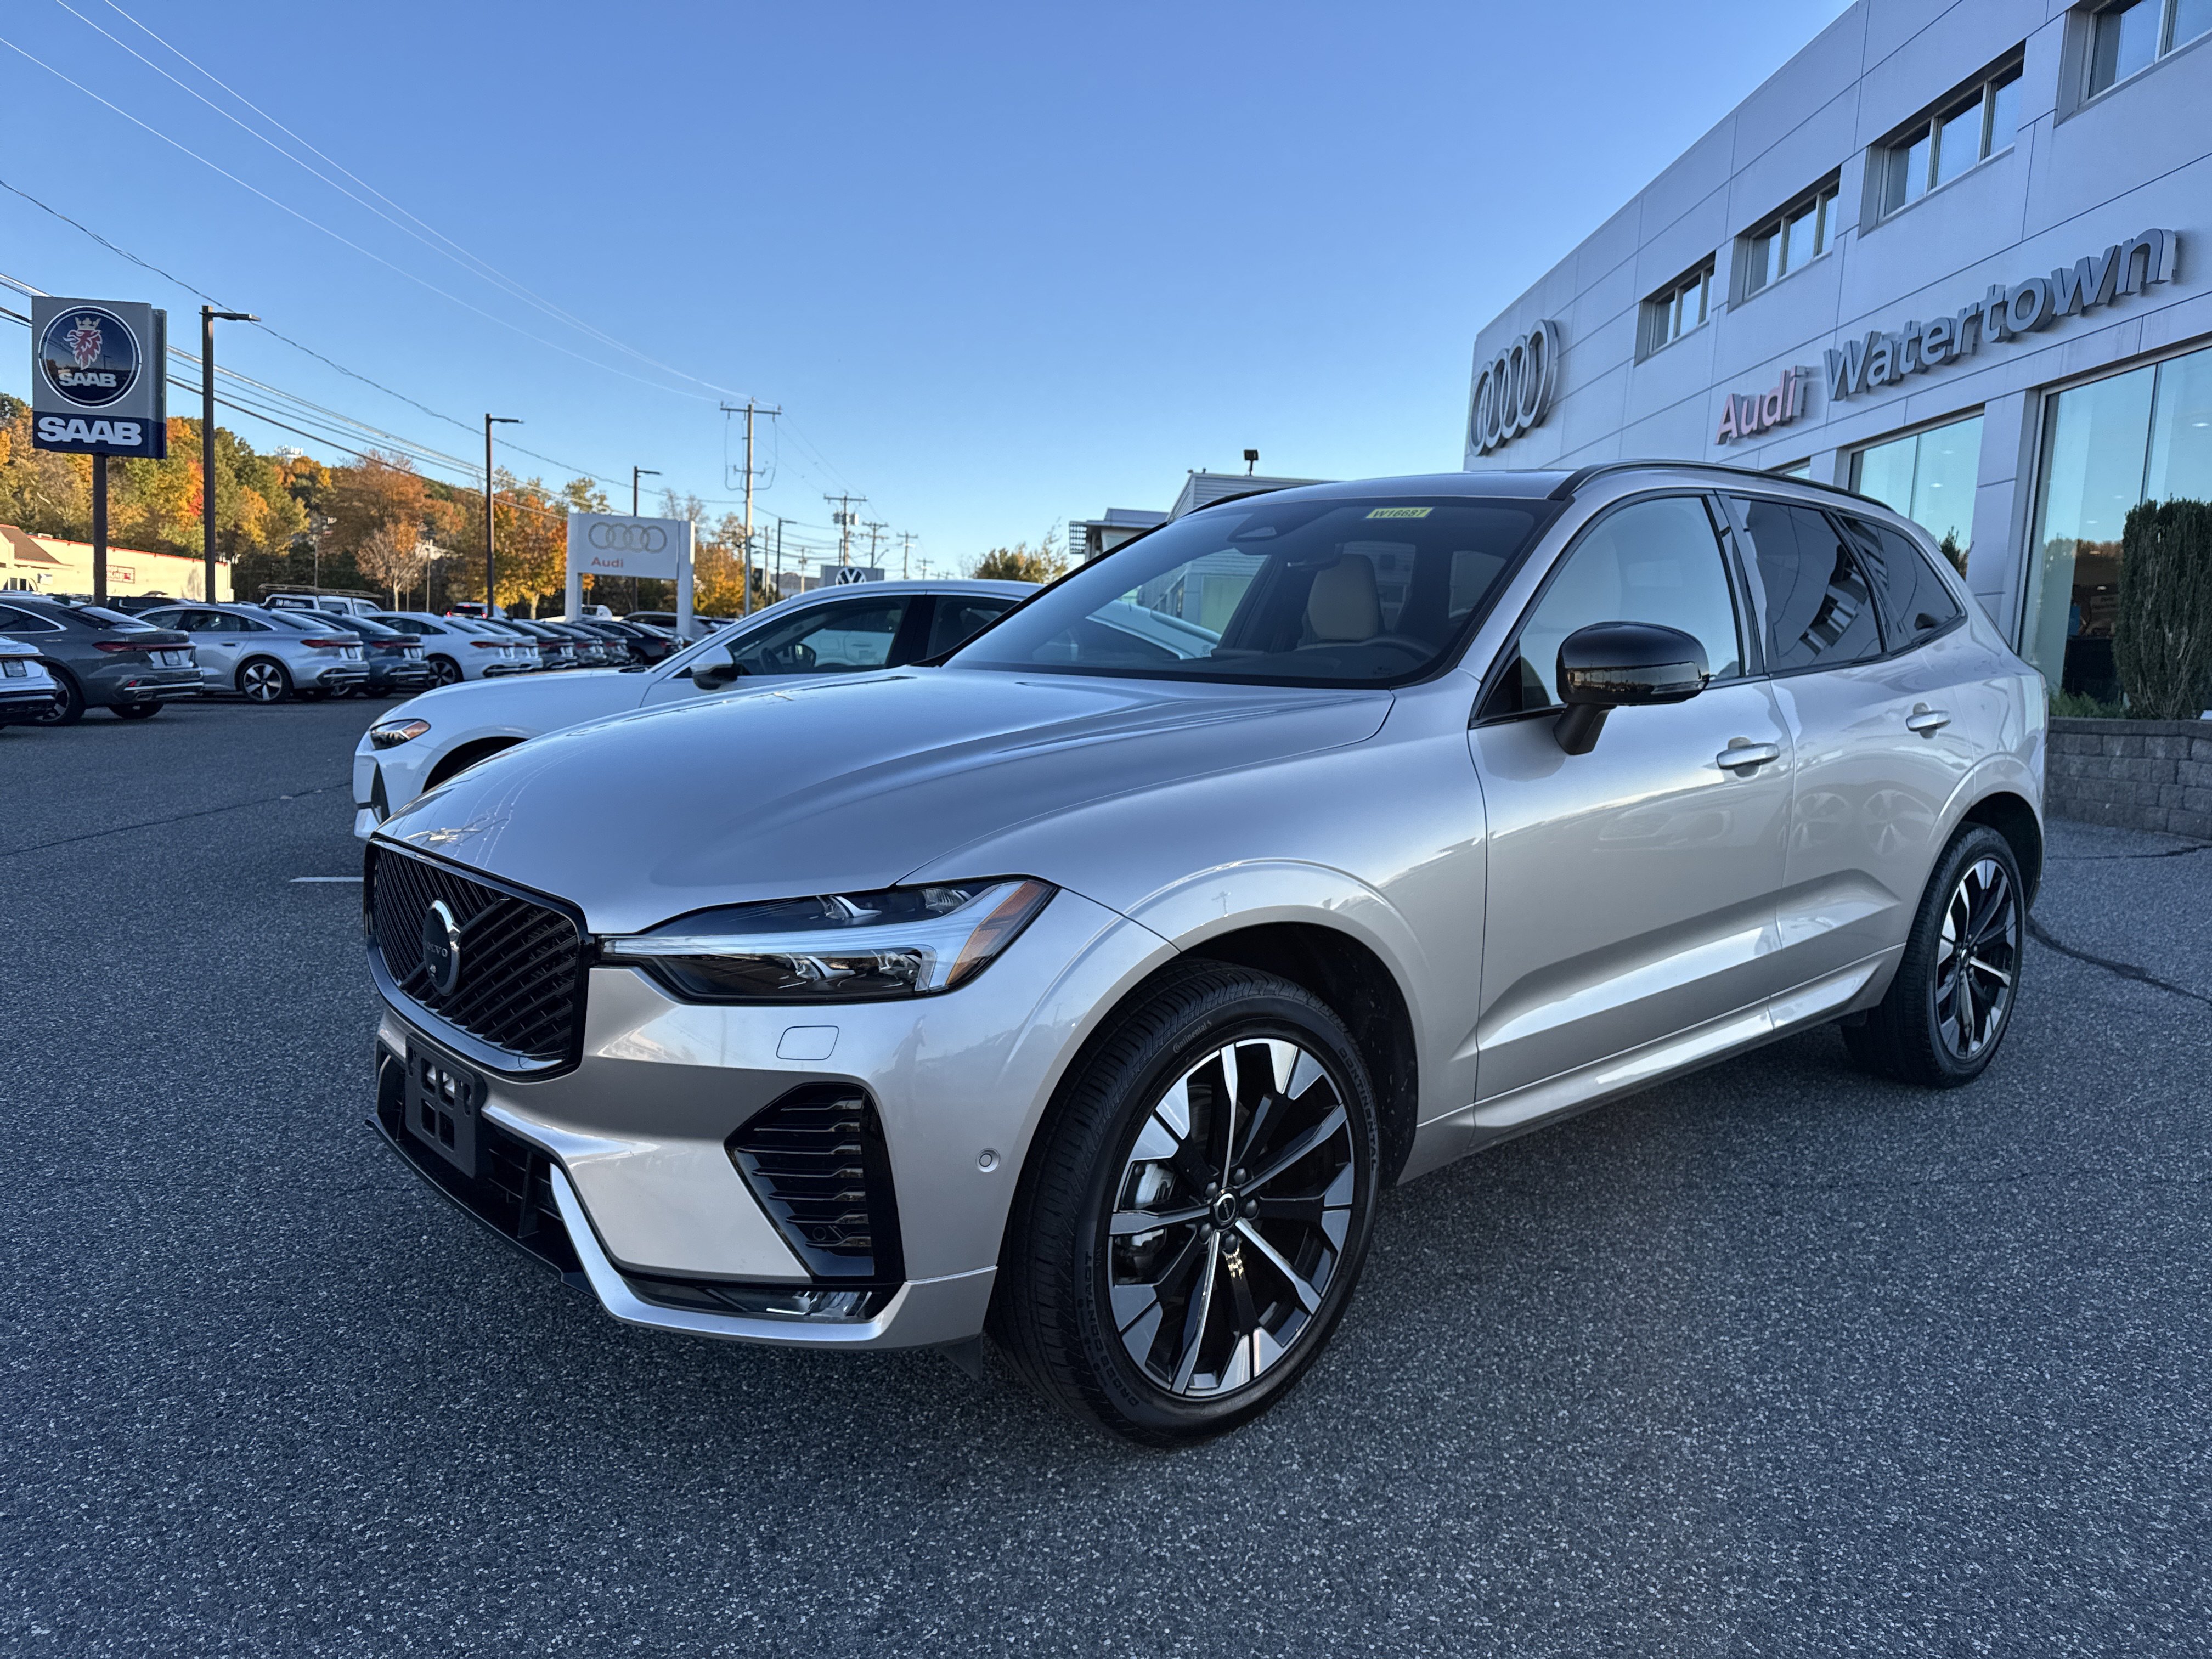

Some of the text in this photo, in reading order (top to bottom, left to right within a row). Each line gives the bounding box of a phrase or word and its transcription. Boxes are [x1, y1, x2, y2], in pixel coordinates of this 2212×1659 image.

[1716, 228, 2178, 444] Audi Watertown
[58, 371, 117, 387] SAAB
[37, 416, 143, 446] SAAB
[591, 557, 624, 568] Audi
[1173, 1022, 1207, 1053] Continental
[1338, 1047, 1378, 1172] CONTINENTAL
